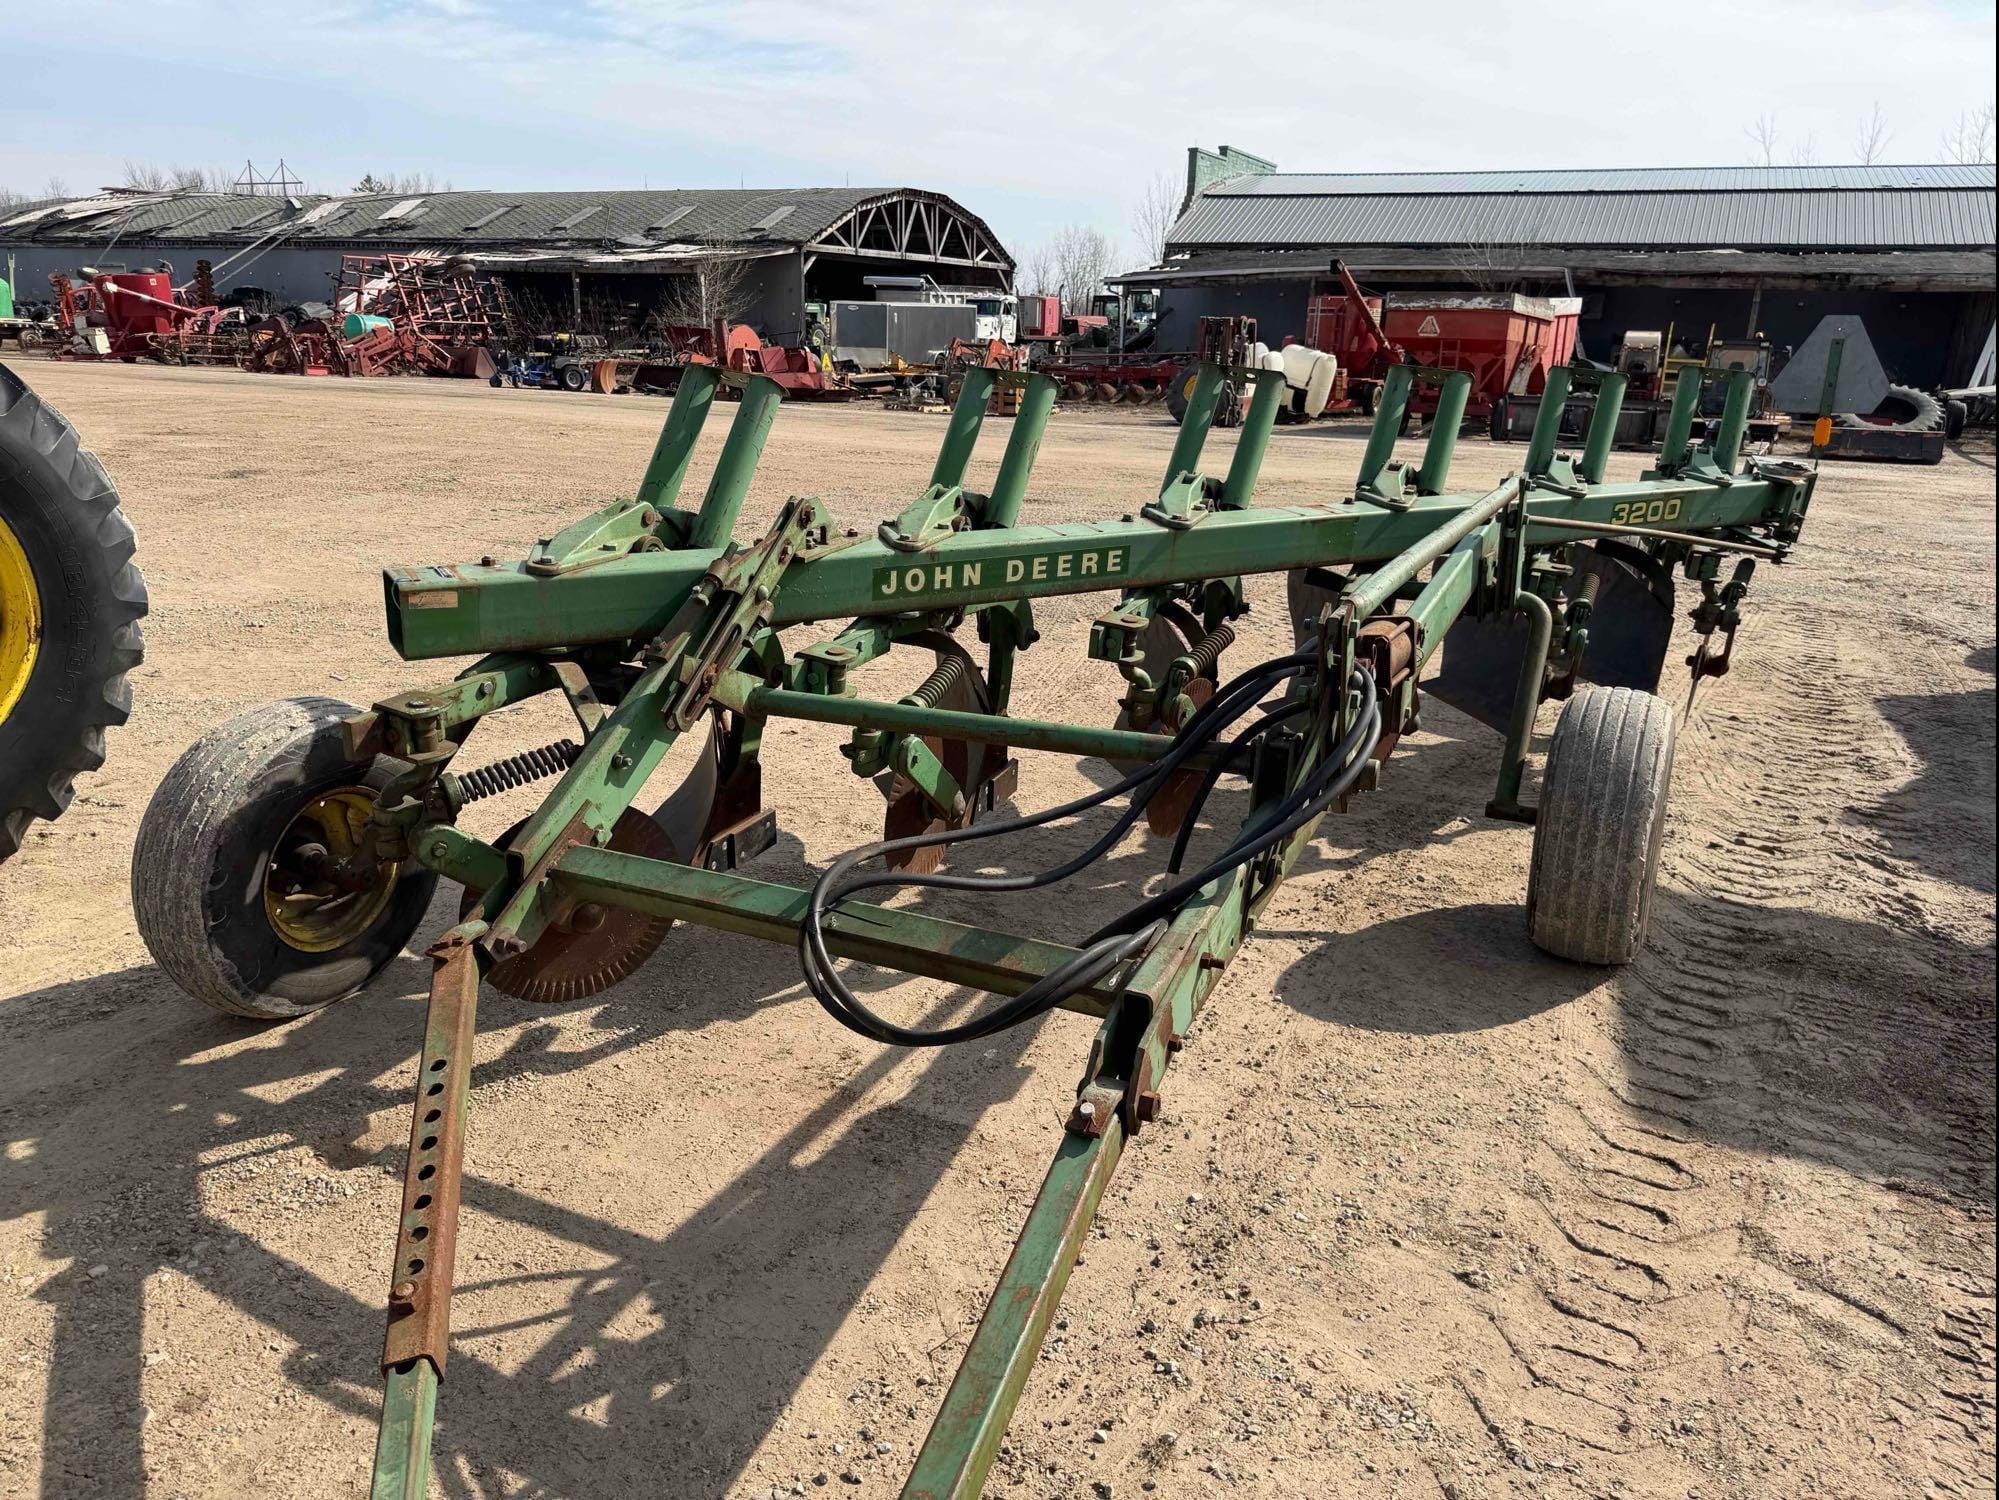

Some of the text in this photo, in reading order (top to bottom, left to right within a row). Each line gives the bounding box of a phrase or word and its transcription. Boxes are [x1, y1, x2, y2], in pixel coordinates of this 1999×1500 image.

[1611, 499, 1682, 525] 3200
[881, 549, 1123, 595] JOHN DEERE
